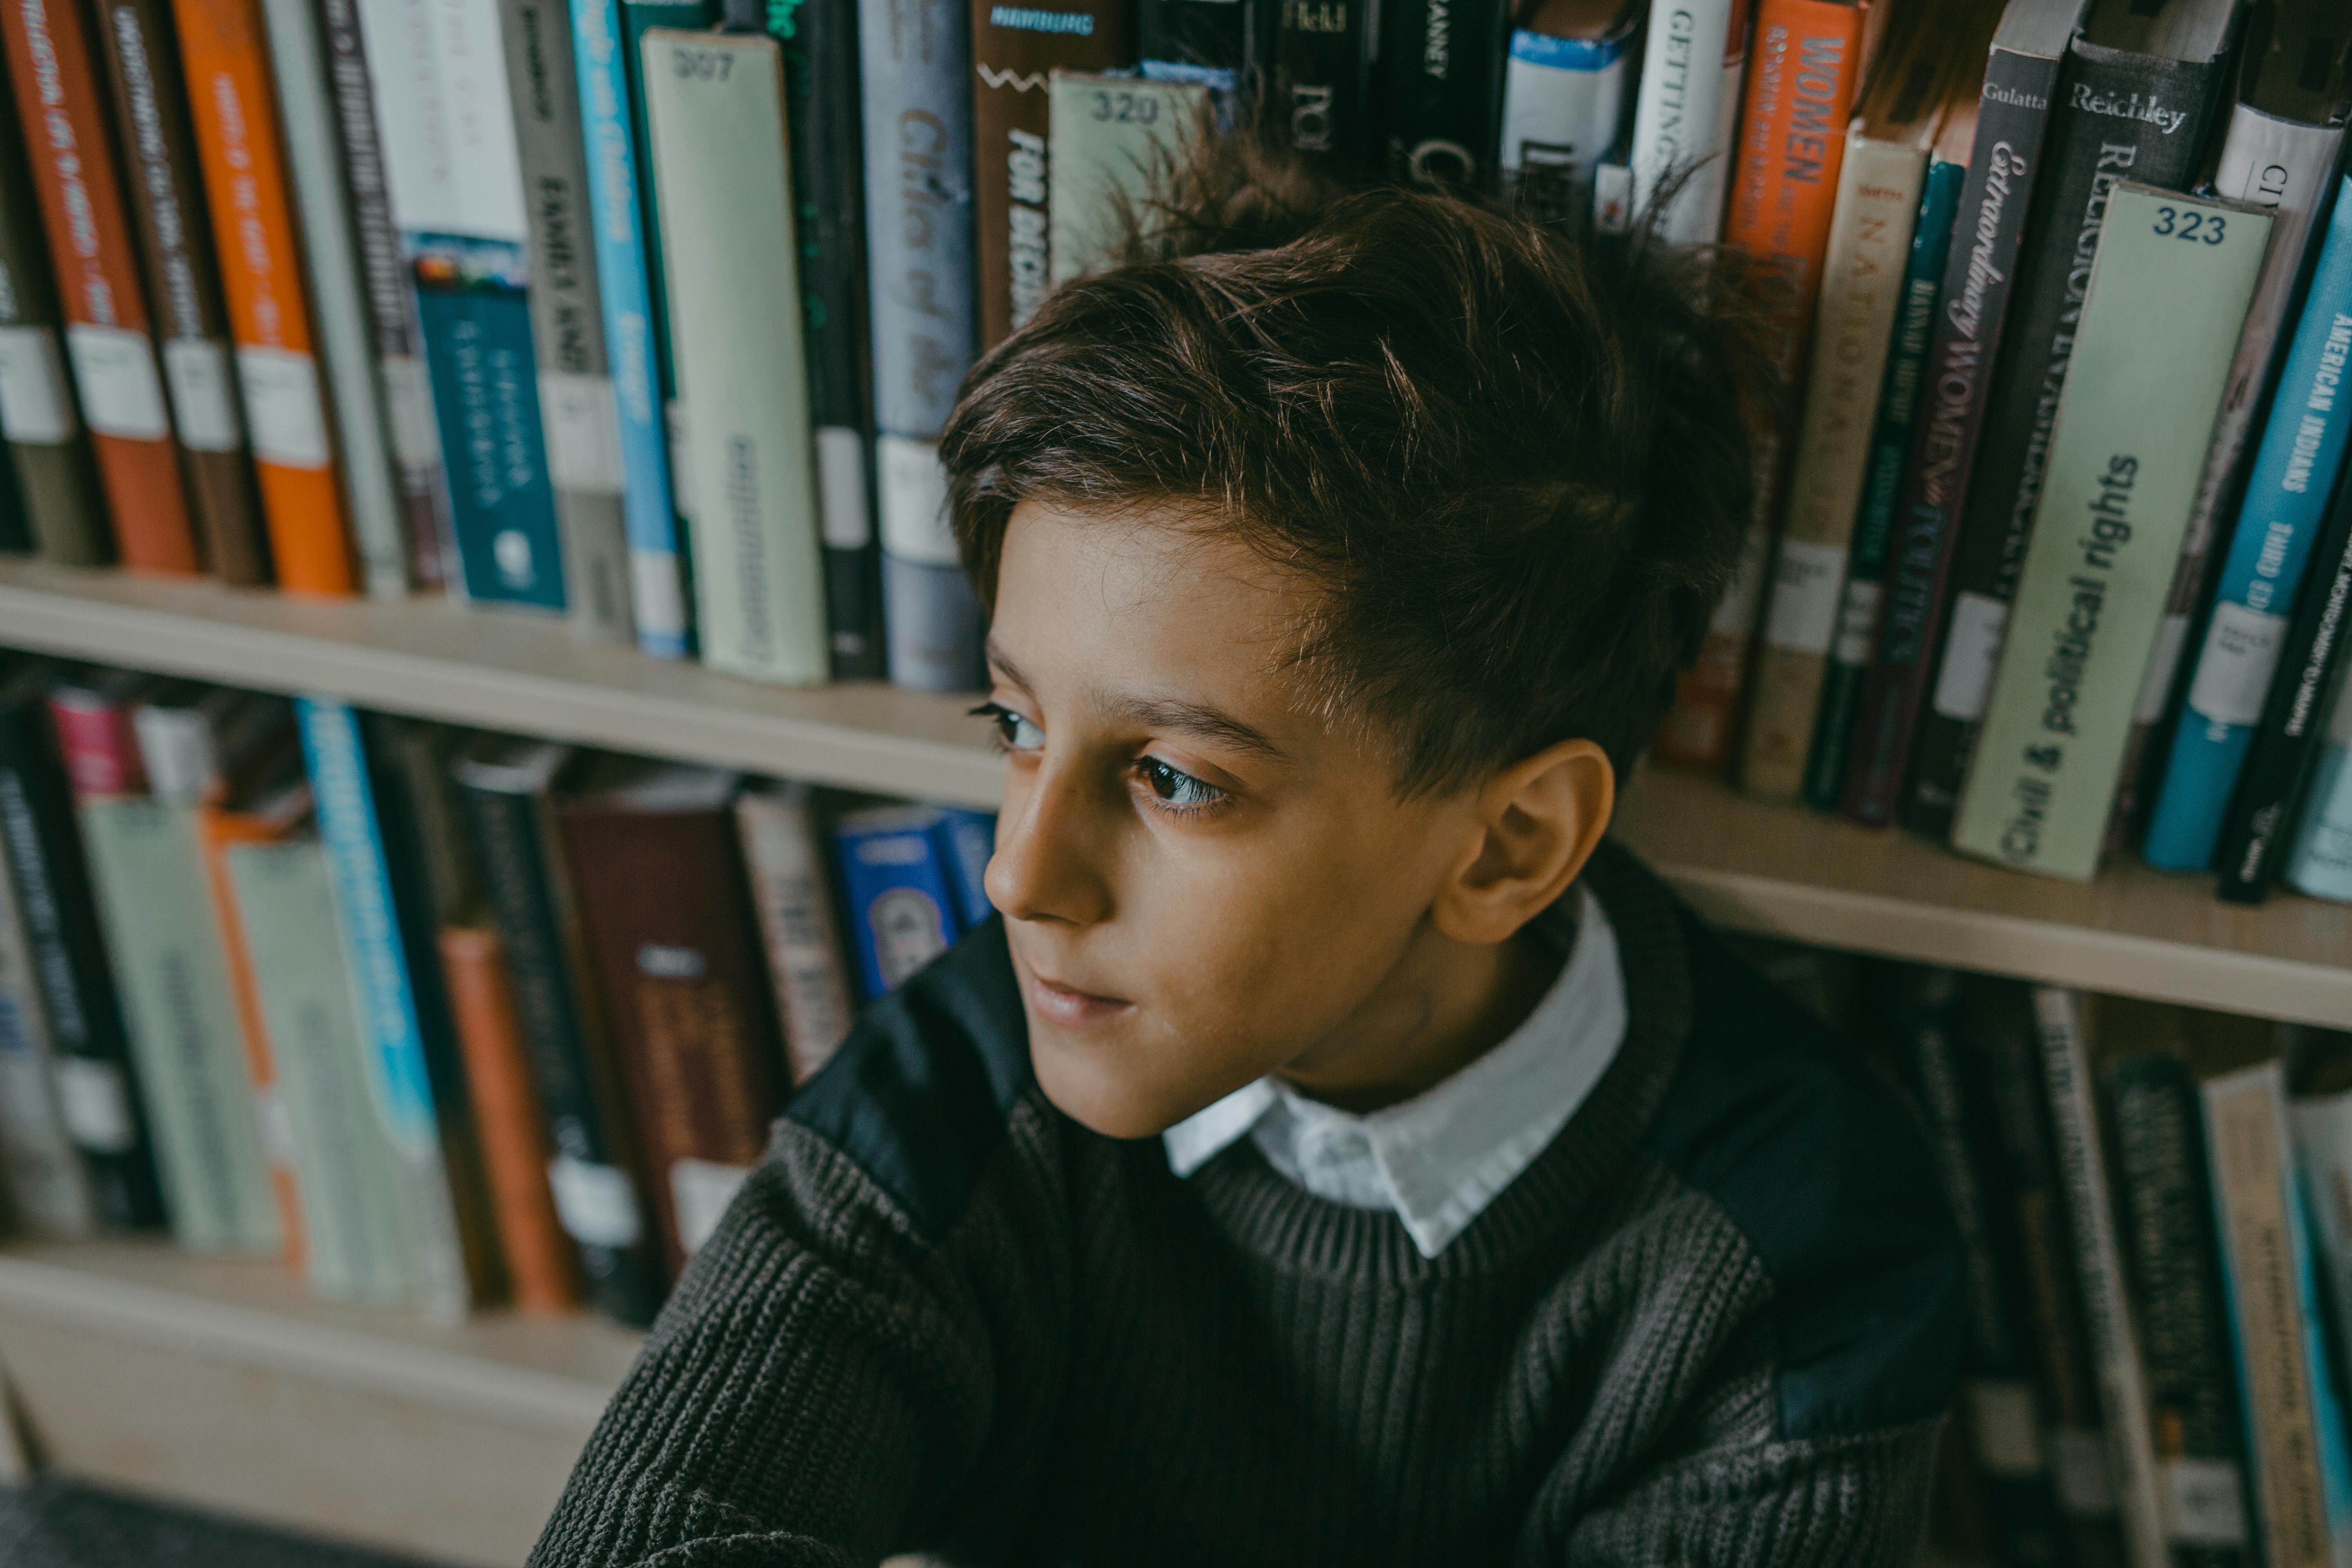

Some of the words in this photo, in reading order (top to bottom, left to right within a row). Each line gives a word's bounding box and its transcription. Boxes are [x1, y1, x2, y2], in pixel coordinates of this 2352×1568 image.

[1091, 91, 1160, 125] 320
[1656, 9, 1695, 161] GETTING
[1783, 36, 1846, 186] WOMEN
[1982, 82, 2048, 110] Gulatta
[2068, 82, 2187, 134] Reichley
[1008, 128, 1046, 205] FOR
[1947, 140, 2028, 341] Extraordinary
[2152, 206, 2227, 246] 323
[2306, 312, 2352, 412] AMERICAN
[1922, 340, 1982, 482] WOMEN
[2282, 414, 2327, 494] INDIANS
[2077, 452, 2139, 571] rights
[2255, 520, 2294, 579] THIRD
[1879, 501, 1946, 666] POLITICS
[2041, 574, 2107, 737] political
[2022, 743, 2062, 773] &
[2000, 775, 2051, 863] Civil
